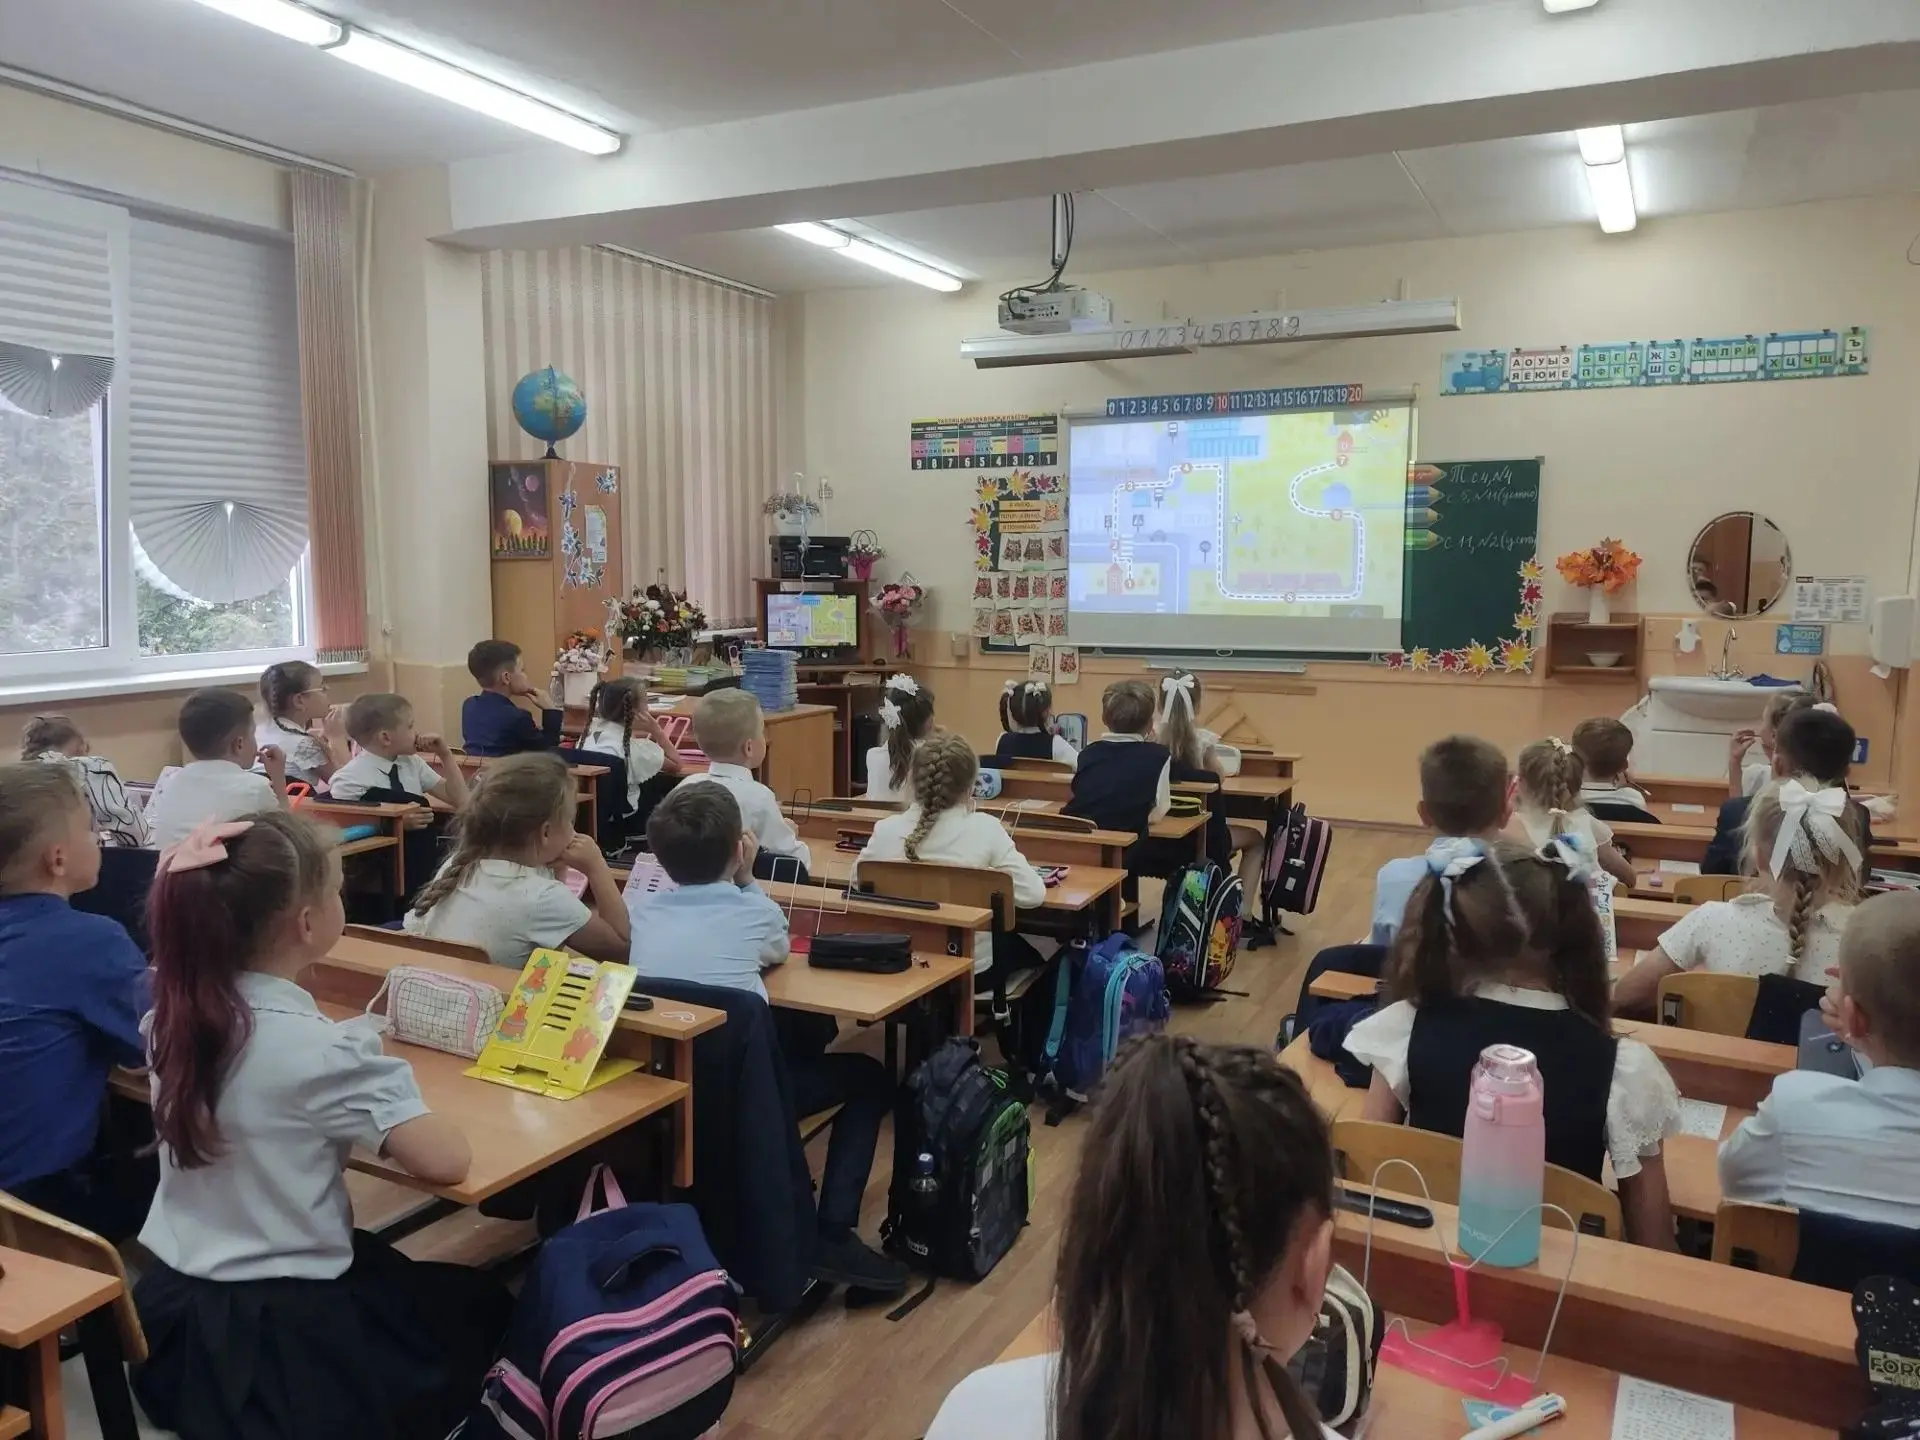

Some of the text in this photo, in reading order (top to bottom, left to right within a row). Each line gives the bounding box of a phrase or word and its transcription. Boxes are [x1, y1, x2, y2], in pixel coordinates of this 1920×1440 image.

[1109, 388, 1361, 415] 0 1 2 3 4 5 6 7 8 9 10 11 12 13 14 15 16 17 18 19 20
[916, 455, 1050, 468] 9 8 7 6 5 4 3 2 1
[1793, 631, 1821, 640] ВОДУ
